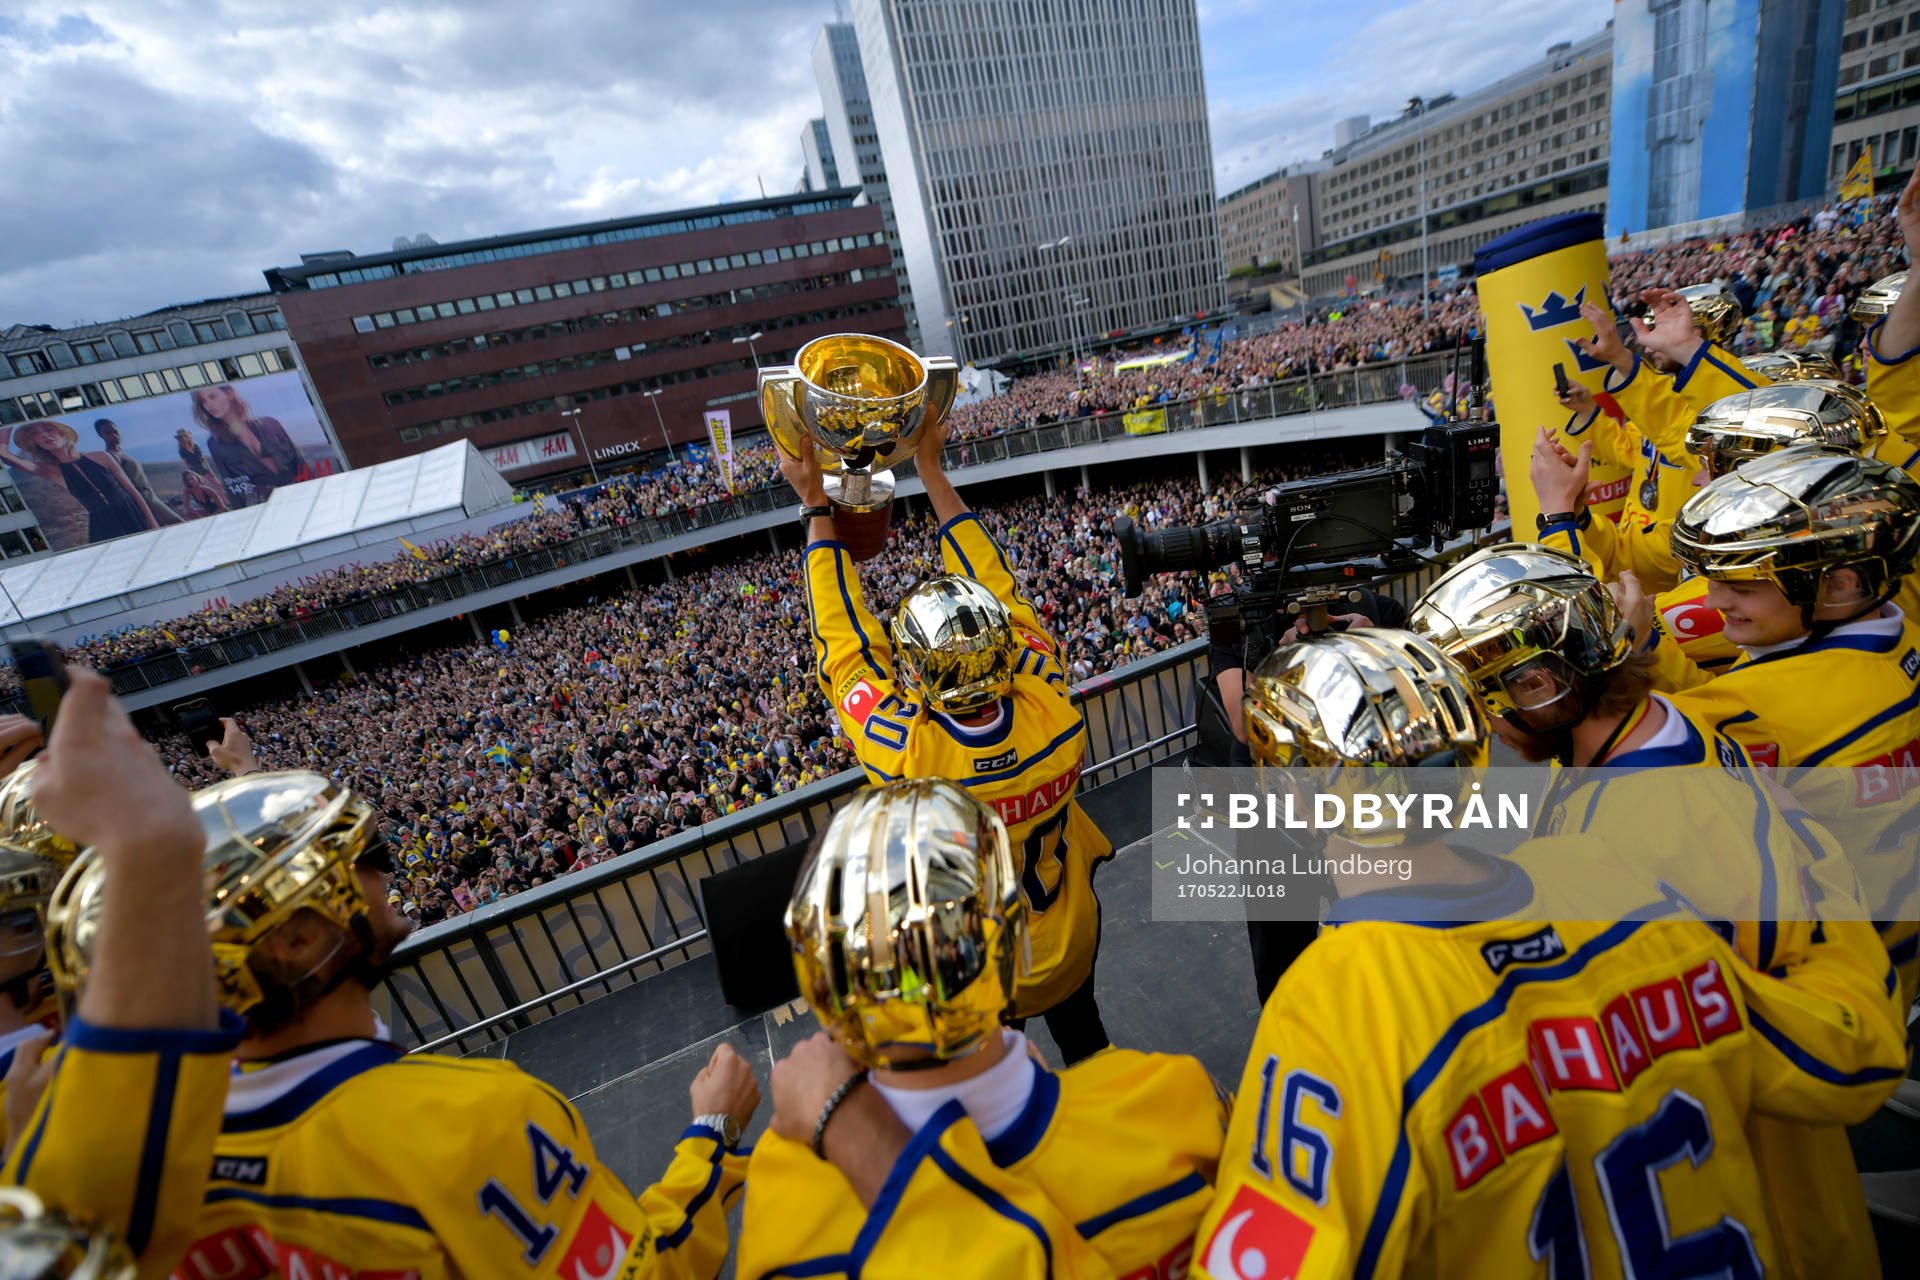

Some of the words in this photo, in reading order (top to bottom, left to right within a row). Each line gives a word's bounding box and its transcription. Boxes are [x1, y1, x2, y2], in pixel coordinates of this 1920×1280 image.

[594, 440, 641, 460] LINDEX
[1289, 503, 1311, 513] SON
[839, 668, 868, 695] SVENSKA
[974, 750, 1018, 772] CCM
[1486, 932, 1563, 969] CCM
[1446, 966, 1733, 1184] BAHAUS
[1250, 1053, 1343, 1208] 16
[476, 1119, 592, 1268] 14
